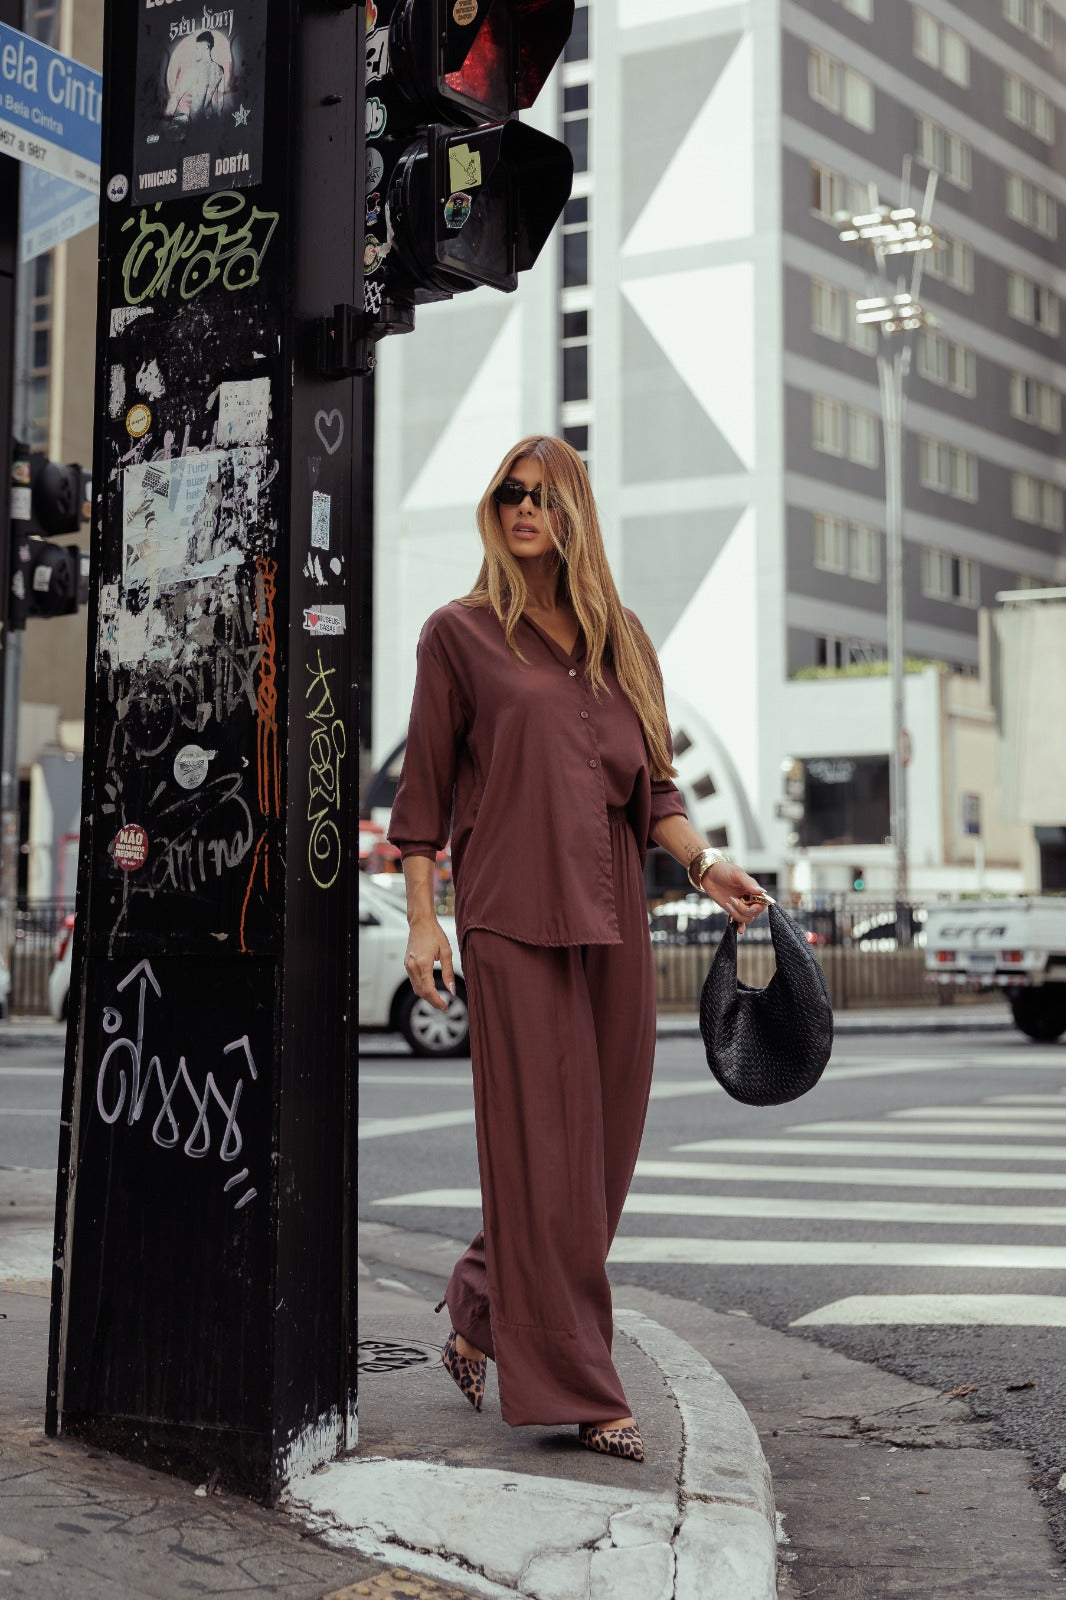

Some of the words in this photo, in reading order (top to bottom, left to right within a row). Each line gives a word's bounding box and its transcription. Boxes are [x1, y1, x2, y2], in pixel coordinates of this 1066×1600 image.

[0, 39, 38, 93] ela
[5, 94, 30, 118] Bela
[31, 107, 64, 136] Cintra
[138, 168, 178, 190] VINICIUS
[215, 153, 250, 176] DORTA
[120, 829, 144, 846] NÃO
